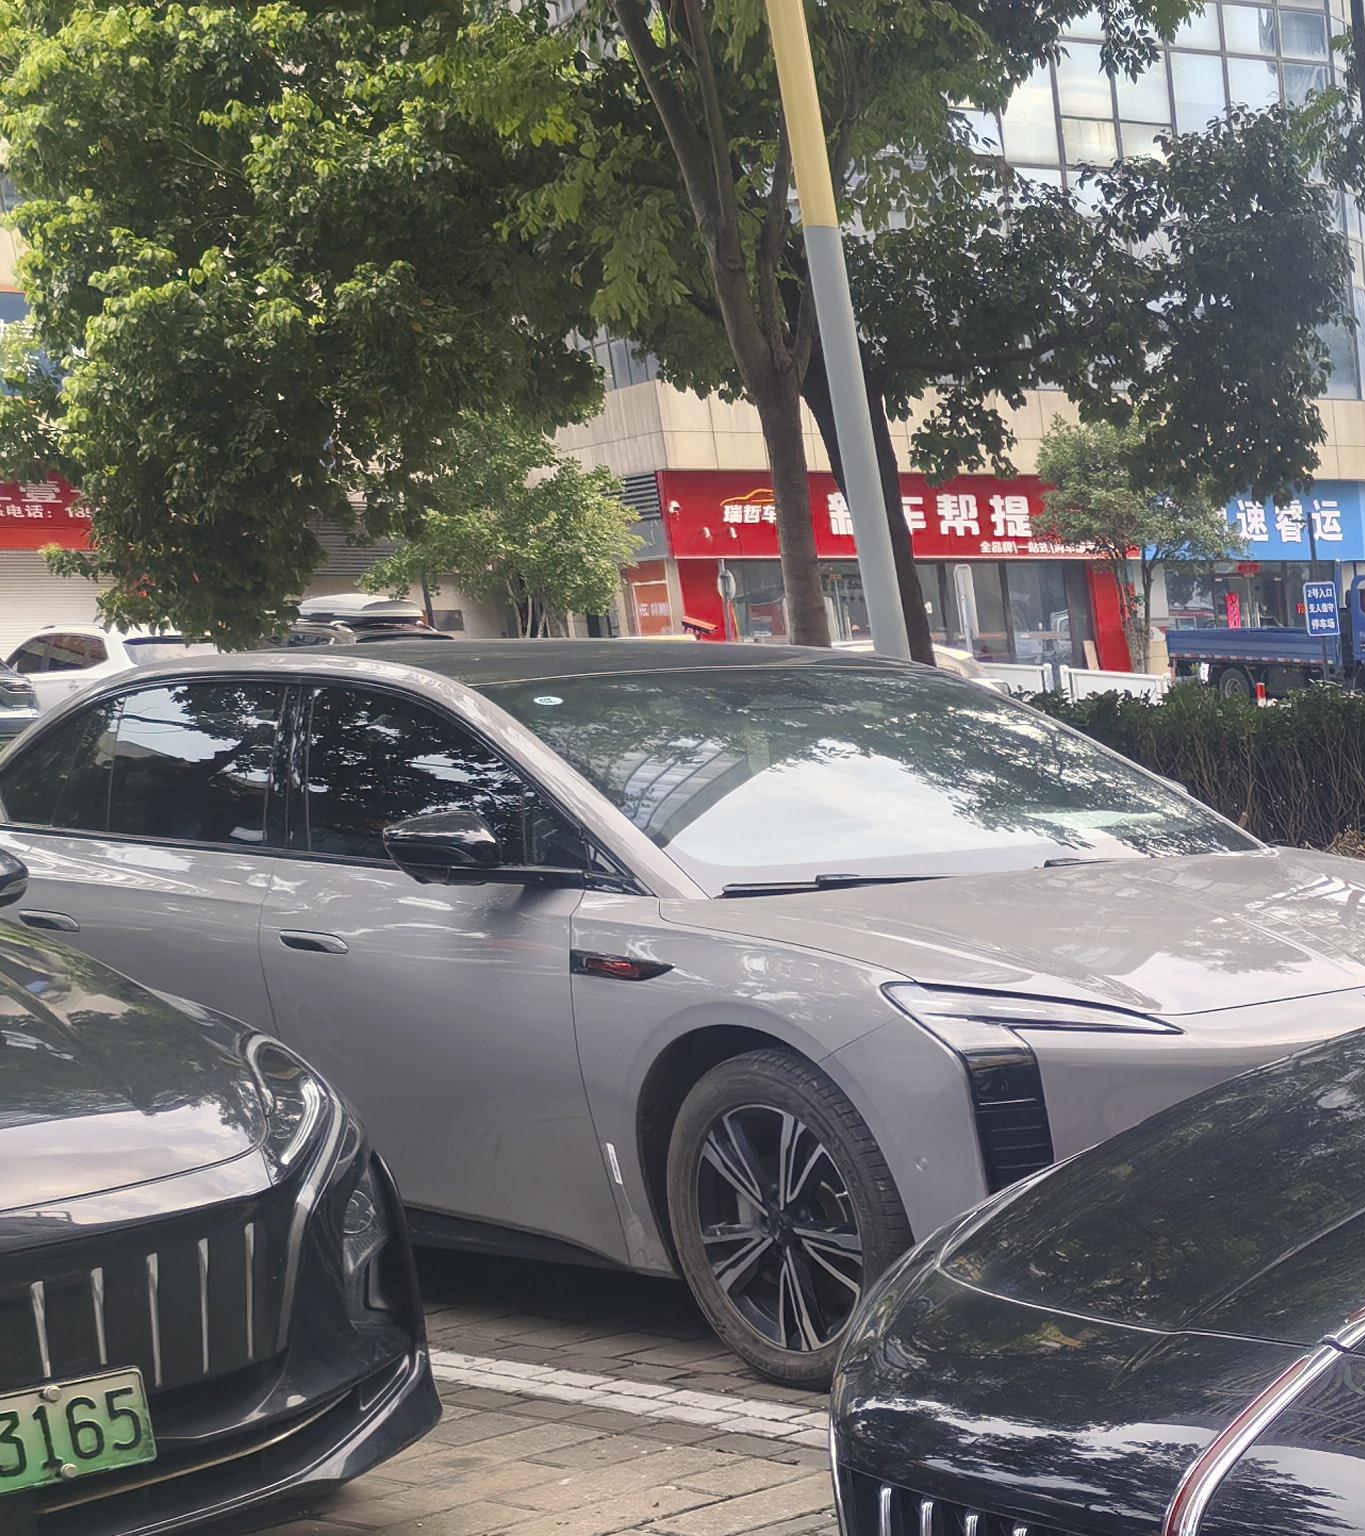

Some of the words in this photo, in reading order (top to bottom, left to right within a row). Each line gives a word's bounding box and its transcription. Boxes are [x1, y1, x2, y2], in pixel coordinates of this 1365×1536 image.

[1307, 588, 1333, 599] 2号入口
[0, 1387, 142, 1478] 3165
